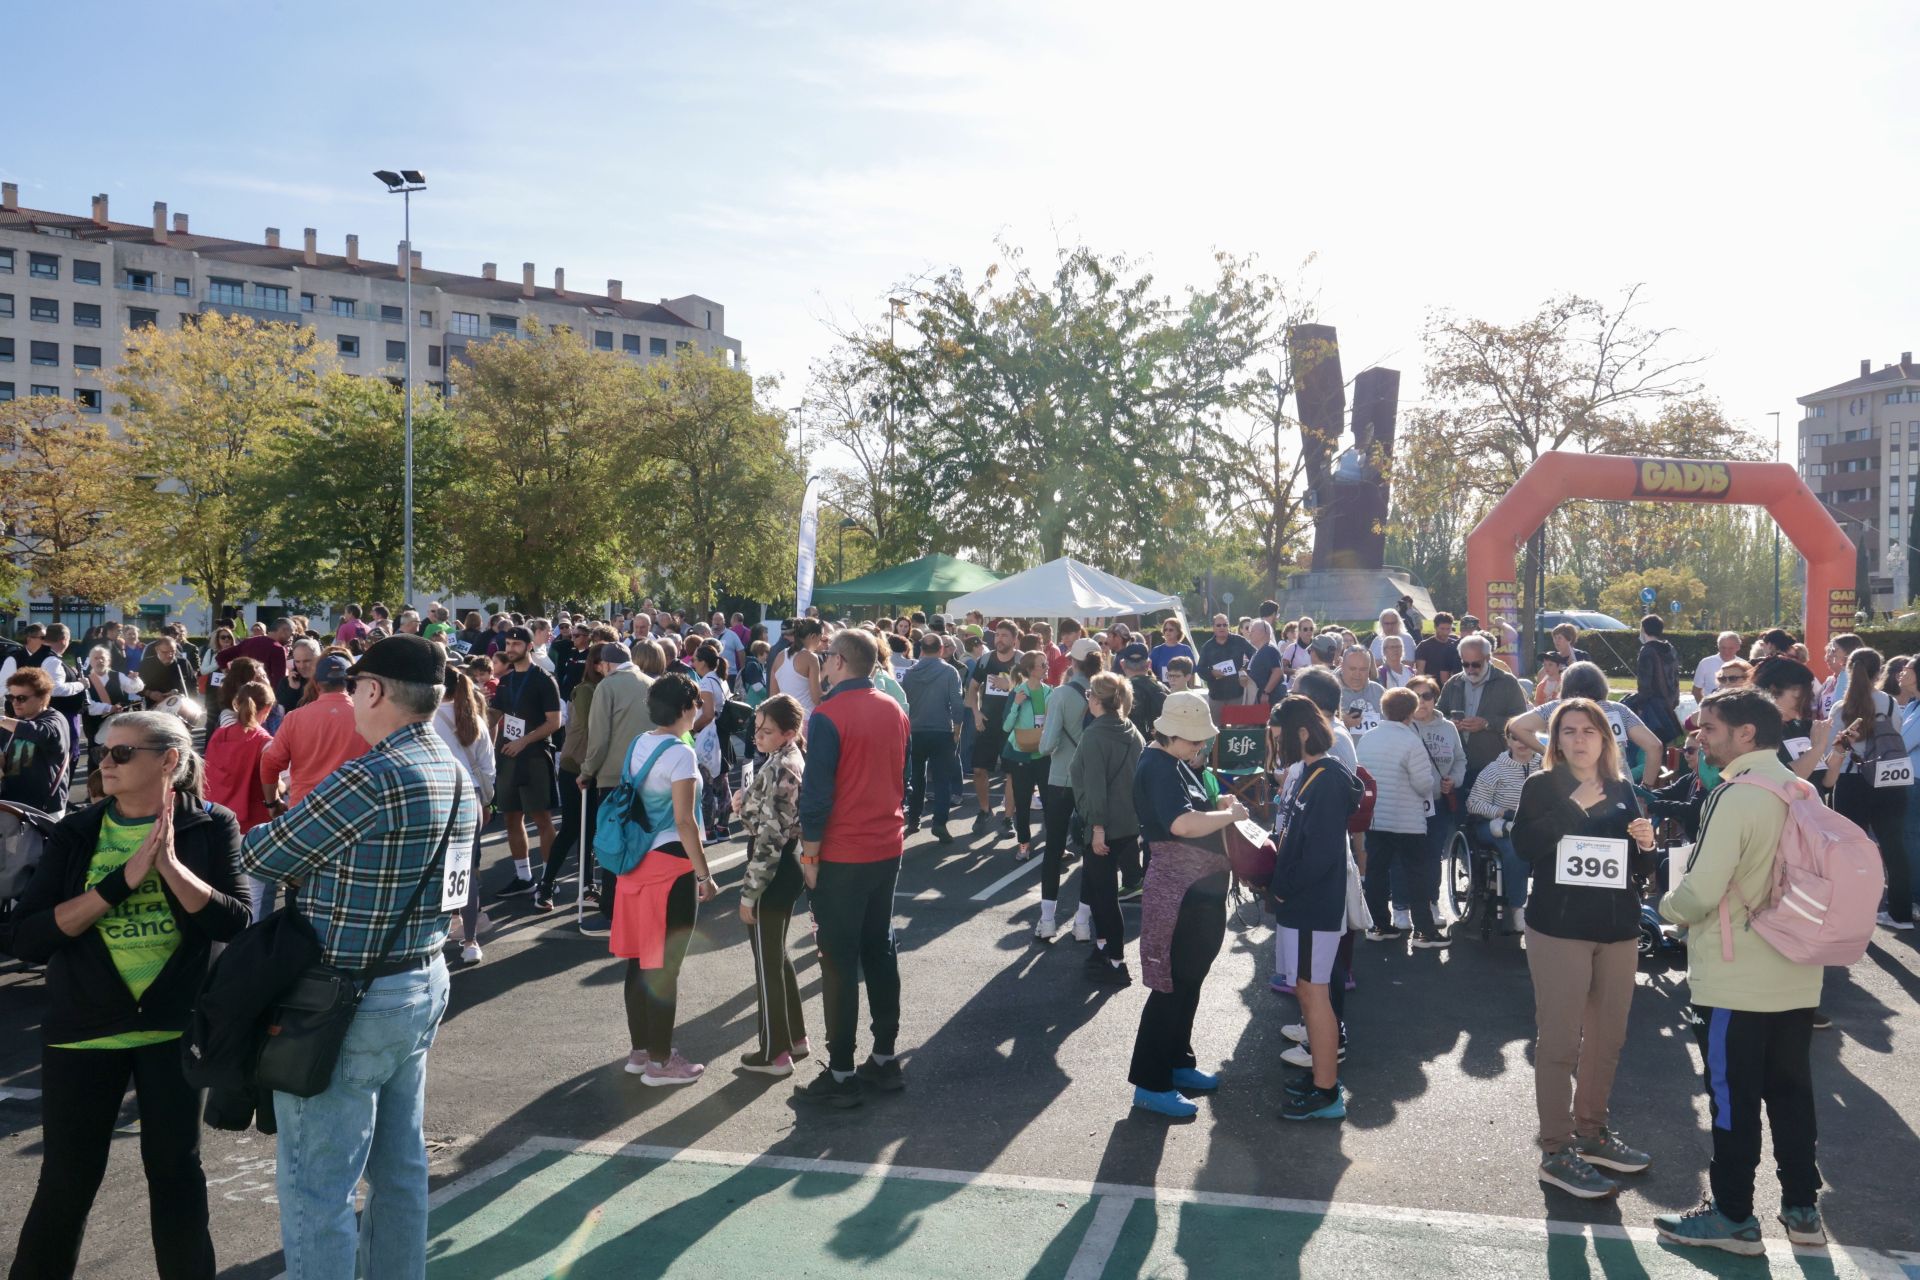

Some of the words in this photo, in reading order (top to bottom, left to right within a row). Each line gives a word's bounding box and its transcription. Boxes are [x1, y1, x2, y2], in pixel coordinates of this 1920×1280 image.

[1641, 462, 1729, 493] GADIS
[506, 724, 522, 738] 552
[1227, 735, 1257, 757] Leffe
[1880, 768, 1910, 782] 200
[1566, 855, 1620, 879] 396
